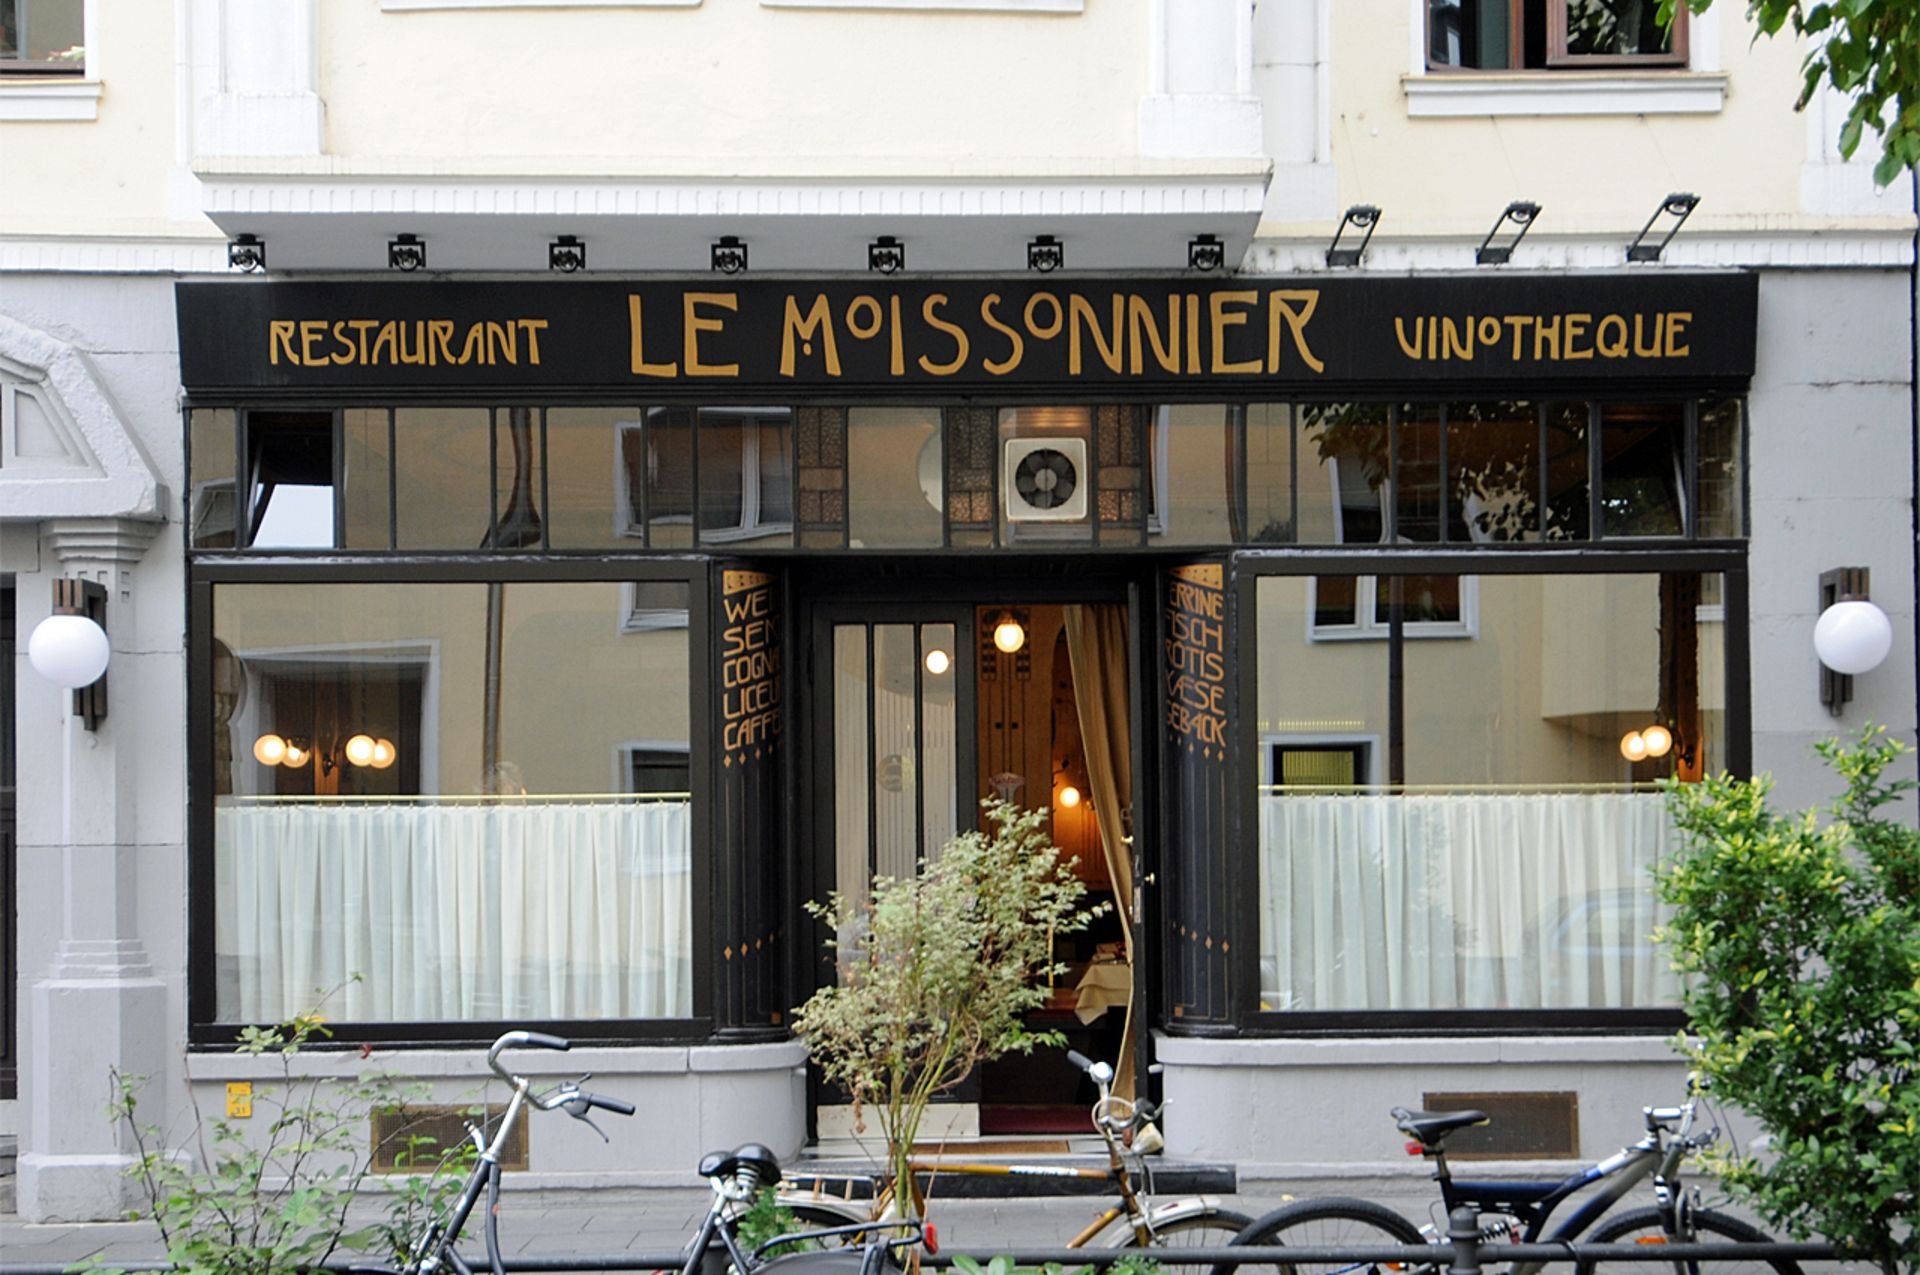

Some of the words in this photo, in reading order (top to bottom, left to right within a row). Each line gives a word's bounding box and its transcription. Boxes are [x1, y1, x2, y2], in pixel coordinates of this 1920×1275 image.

[270, 319, 548, 367] RESTAURANT
[628, 292, 740, 378] LE
[779, 289, 1325, 377] MOISSONNIER
[1394, 312, 1693, 361] VINOTHEQUE
